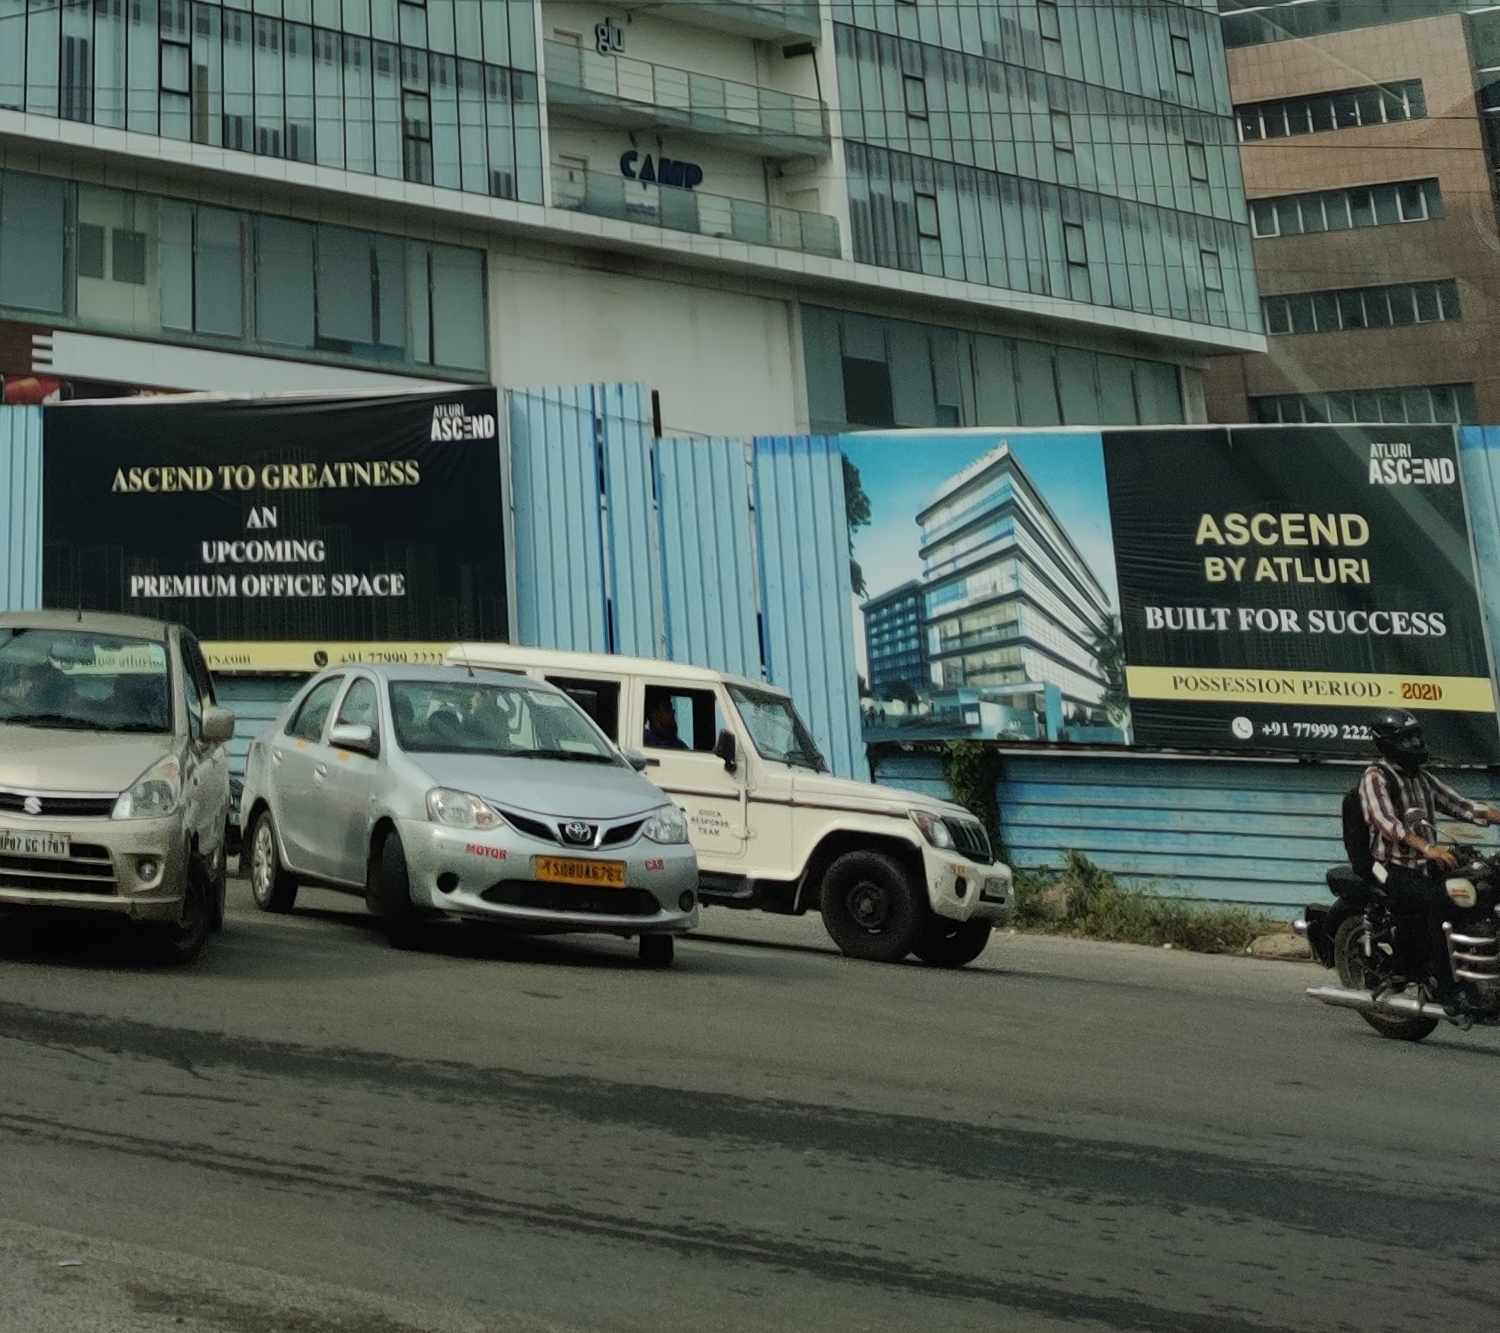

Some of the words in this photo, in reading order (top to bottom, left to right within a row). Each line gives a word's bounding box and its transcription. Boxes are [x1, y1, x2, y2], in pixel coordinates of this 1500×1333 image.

[594, 15, 626, 57] glu
[433, 403, 465, 418] ATLURI
[430, 414, 495, 442] ASCEND
[1370, 442, 1412, 458] ATLURI
[111, 465, 214, 493] ASCEND
[218, 464, 256, 491] TO
[261, 460, 421, 490] GREATNESS
[1368, 457, 1456, 484] ASCEND
[246, 505, 278, 529] AN
[1195, 512, 1370, 547] ASCEND
[201, 539, 326, 564] UPCOMING
[1203, 556, 1247, 582] BY
[1254, 556, 1371, 584] ATLURI
[130, 574, 237, 598] PREMIUM
[241, 573, 327, 598] OFFICE
[331, 572, 406, 597] SPACE
[1143, 605, 1232, 631] BUILT
[1238, 607, 1302, 633] FOR
[1308, 609, 1447, 637] SUCCESS
[1172, 674, 1296, 695] POSSESSION
[1301, 679, 1382, 698] PERIOD
[1261, 721, 1290, 737] +91
[1293, 722, 1338, 739] 77999
[466, 842, 508, 861] MOTOR
